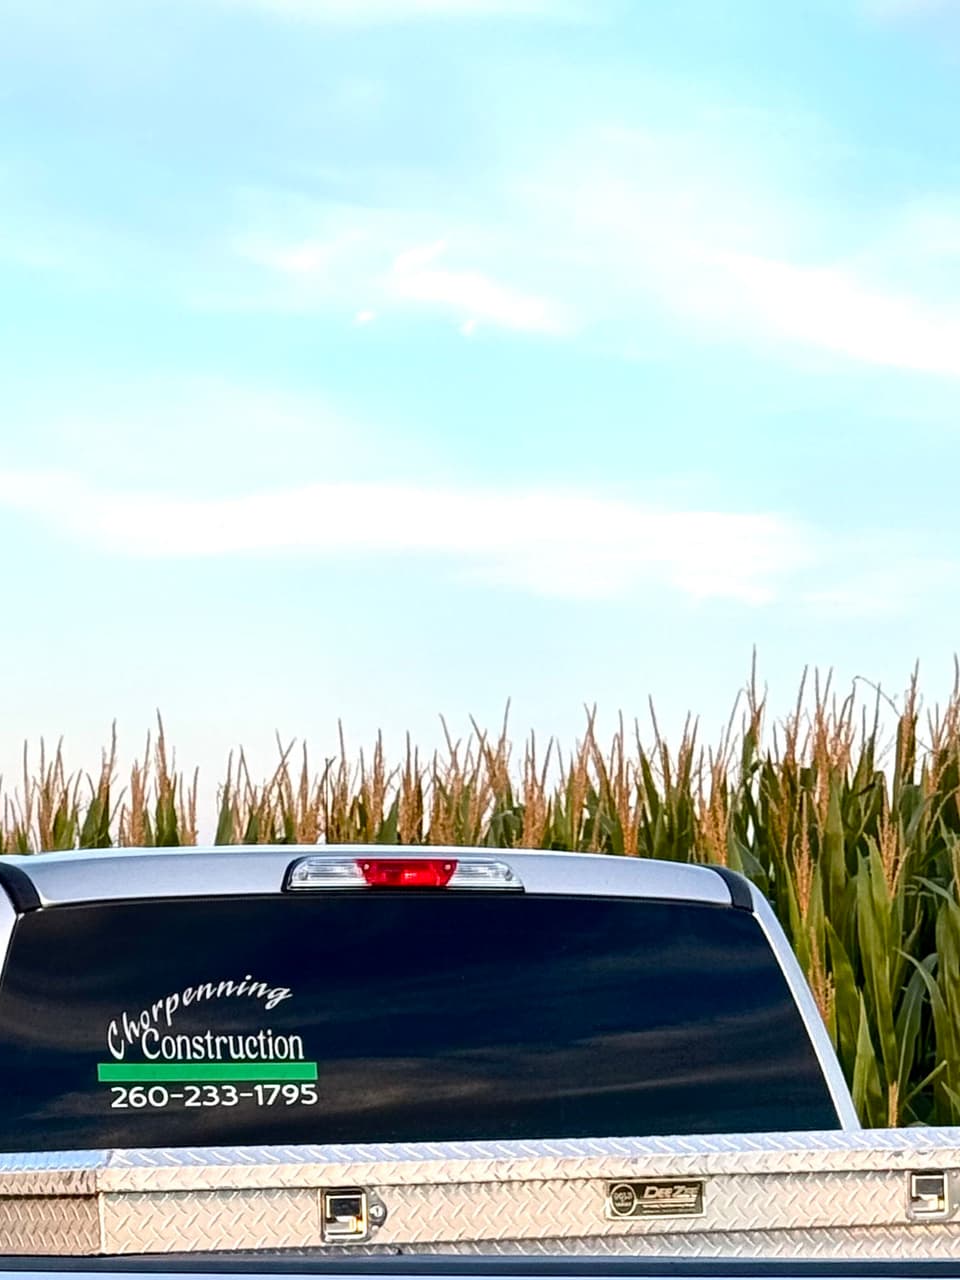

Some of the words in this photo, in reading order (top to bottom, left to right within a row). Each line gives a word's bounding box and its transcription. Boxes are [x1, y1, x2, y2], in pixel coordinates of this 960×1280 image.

[107, 974, 293, 1060] Chorpenning
[141, 1027, 305, 1060] Construction
[111, 1084, 319, 1108] 260-233-1795
